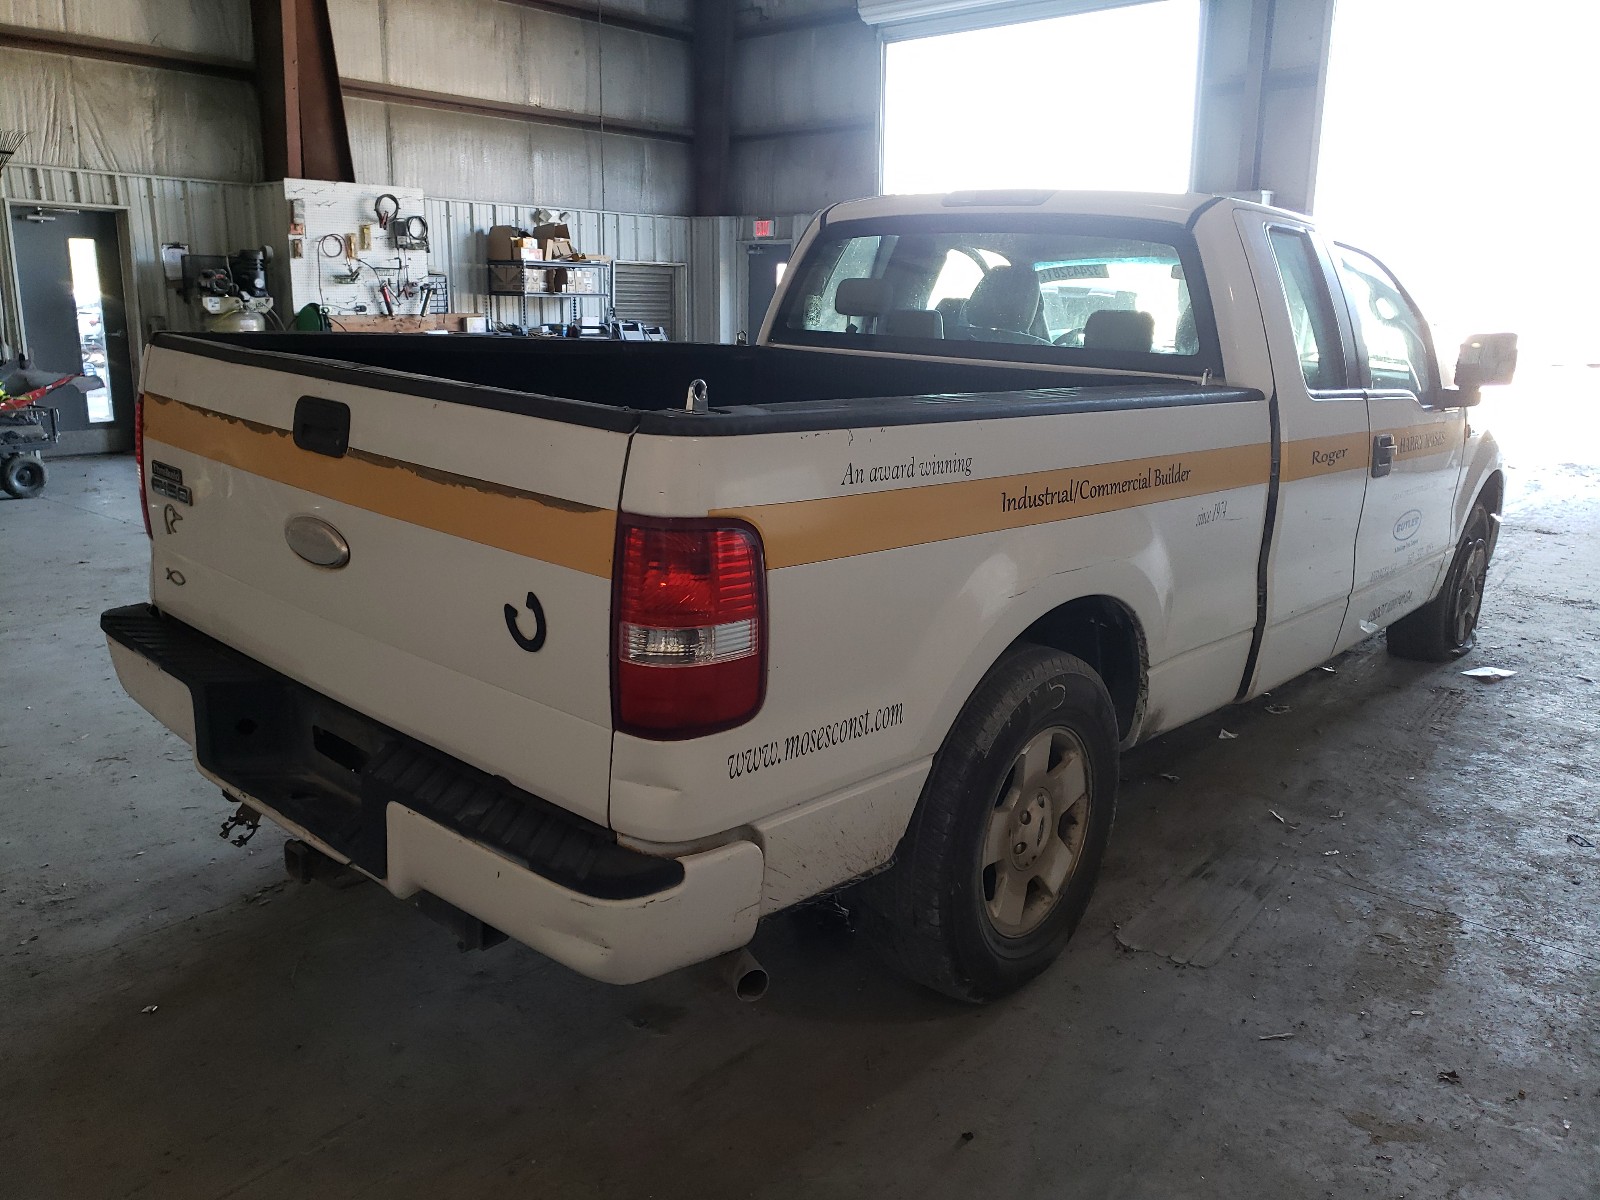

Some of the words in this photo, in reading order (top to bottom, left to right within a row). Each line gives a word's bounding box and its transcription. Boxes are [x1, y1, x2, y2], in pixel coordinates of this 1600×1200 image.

[841, 462, 866, 486] An
[869, 456, 915, 481] award
[918, 452, 973, 477] winning
[1312, 448, 1348, 466] Roger
[1001, 476, 1152, 512] Industrial/Commercial
[1154, 465, 1192, 488] Builder
[727, 702, 904, 779] www.mosesconst.com
